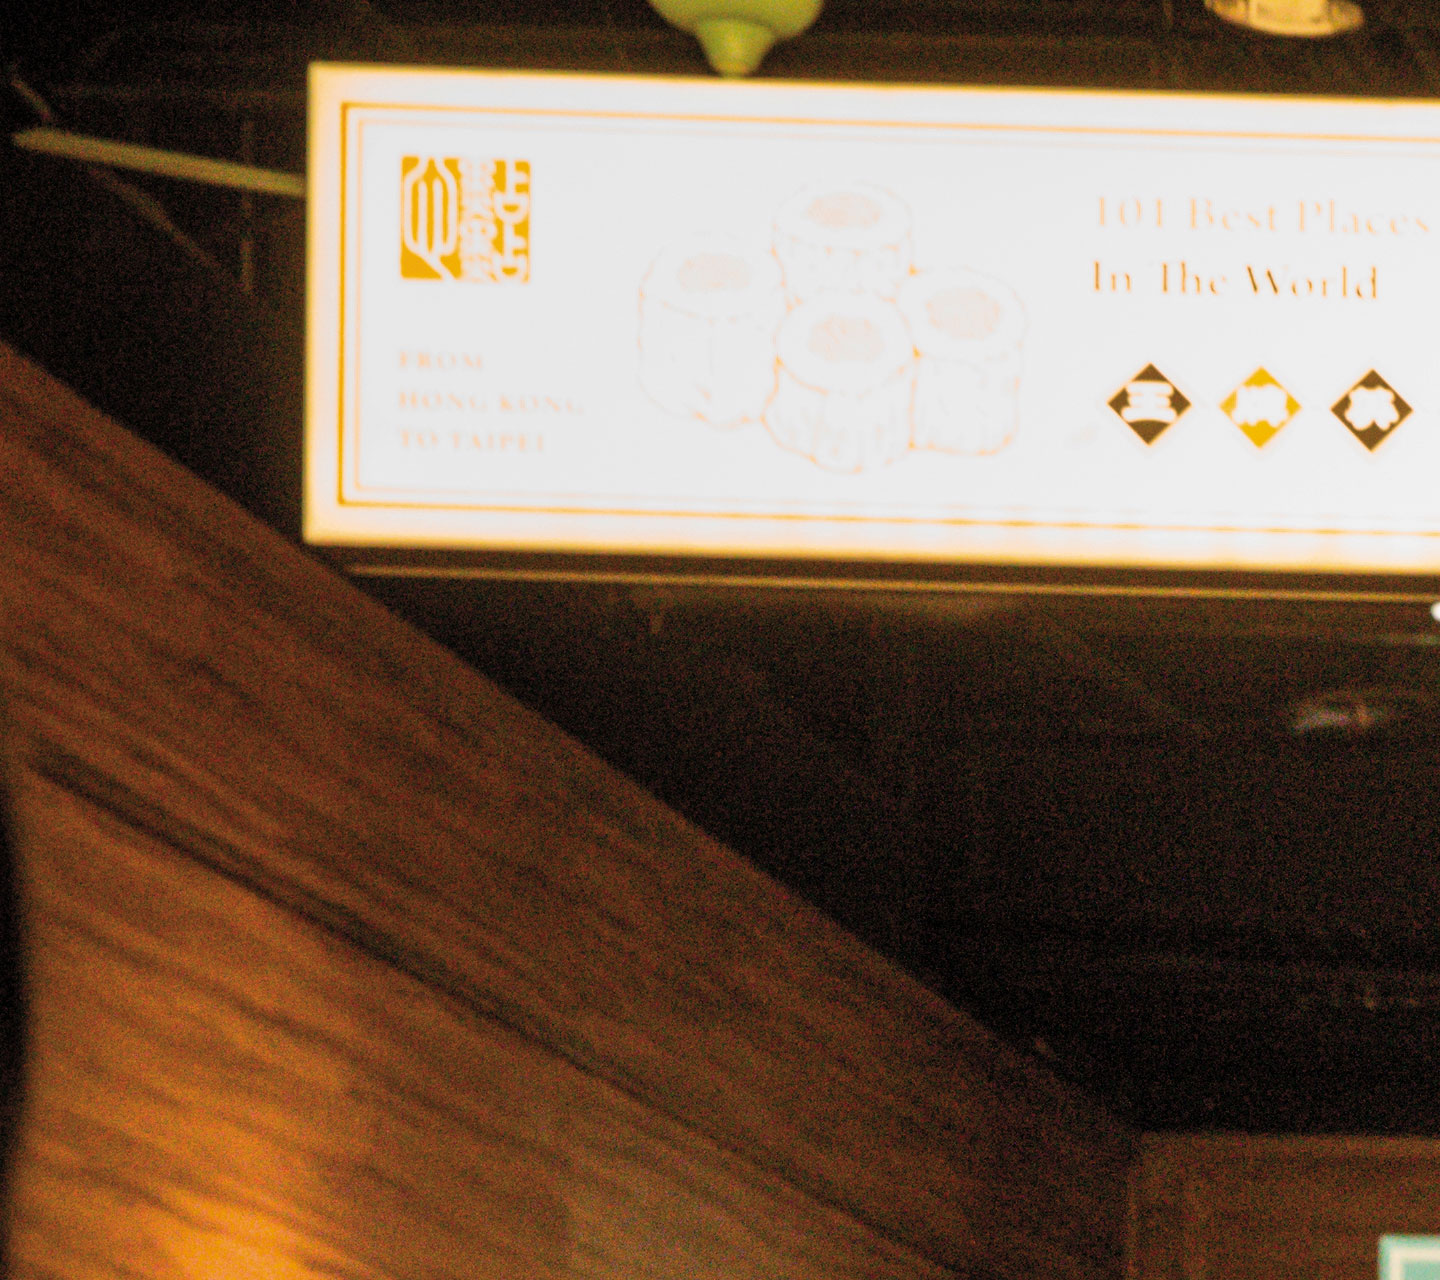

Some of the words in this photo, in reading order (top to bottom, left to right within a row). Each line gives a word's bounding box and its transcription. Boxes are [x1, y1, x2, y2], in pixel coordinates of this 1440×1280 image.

[1096, 196, 1167, 229] 101
[1188, 197, 1280, 232] Best
[1297, 199, 1430, 235] Places
[1091, 260, 1133, 293] In
[1154, 261, 1229, 296] The
[1244, 264, 1380, 300] World
